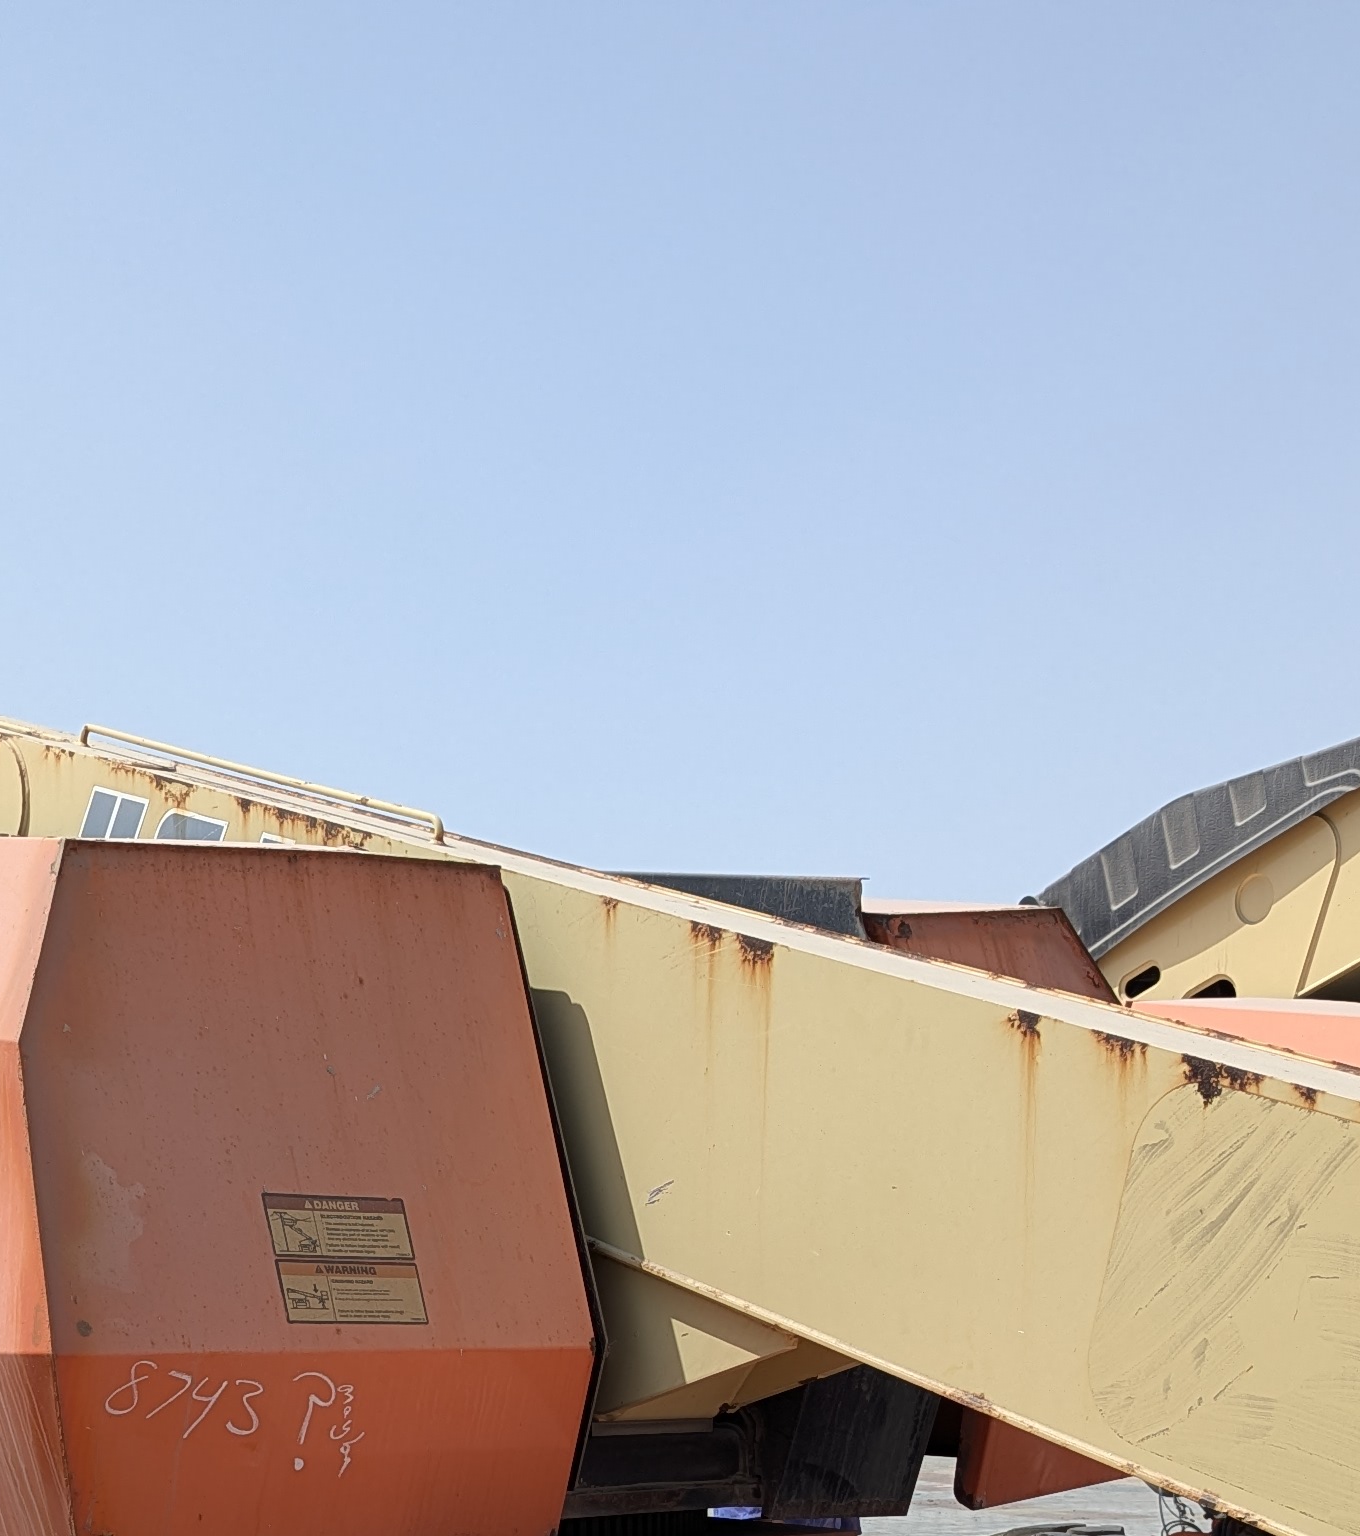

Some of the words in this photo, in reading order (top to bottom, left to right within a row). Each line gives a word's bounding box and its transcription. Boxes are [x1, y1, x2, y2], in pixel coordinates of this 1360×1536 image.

[313, 1200, 360, 1211] DANGER
[324, 1265, 377, 1276] WARNING
[105, 1360, 264, 1439] 8743
